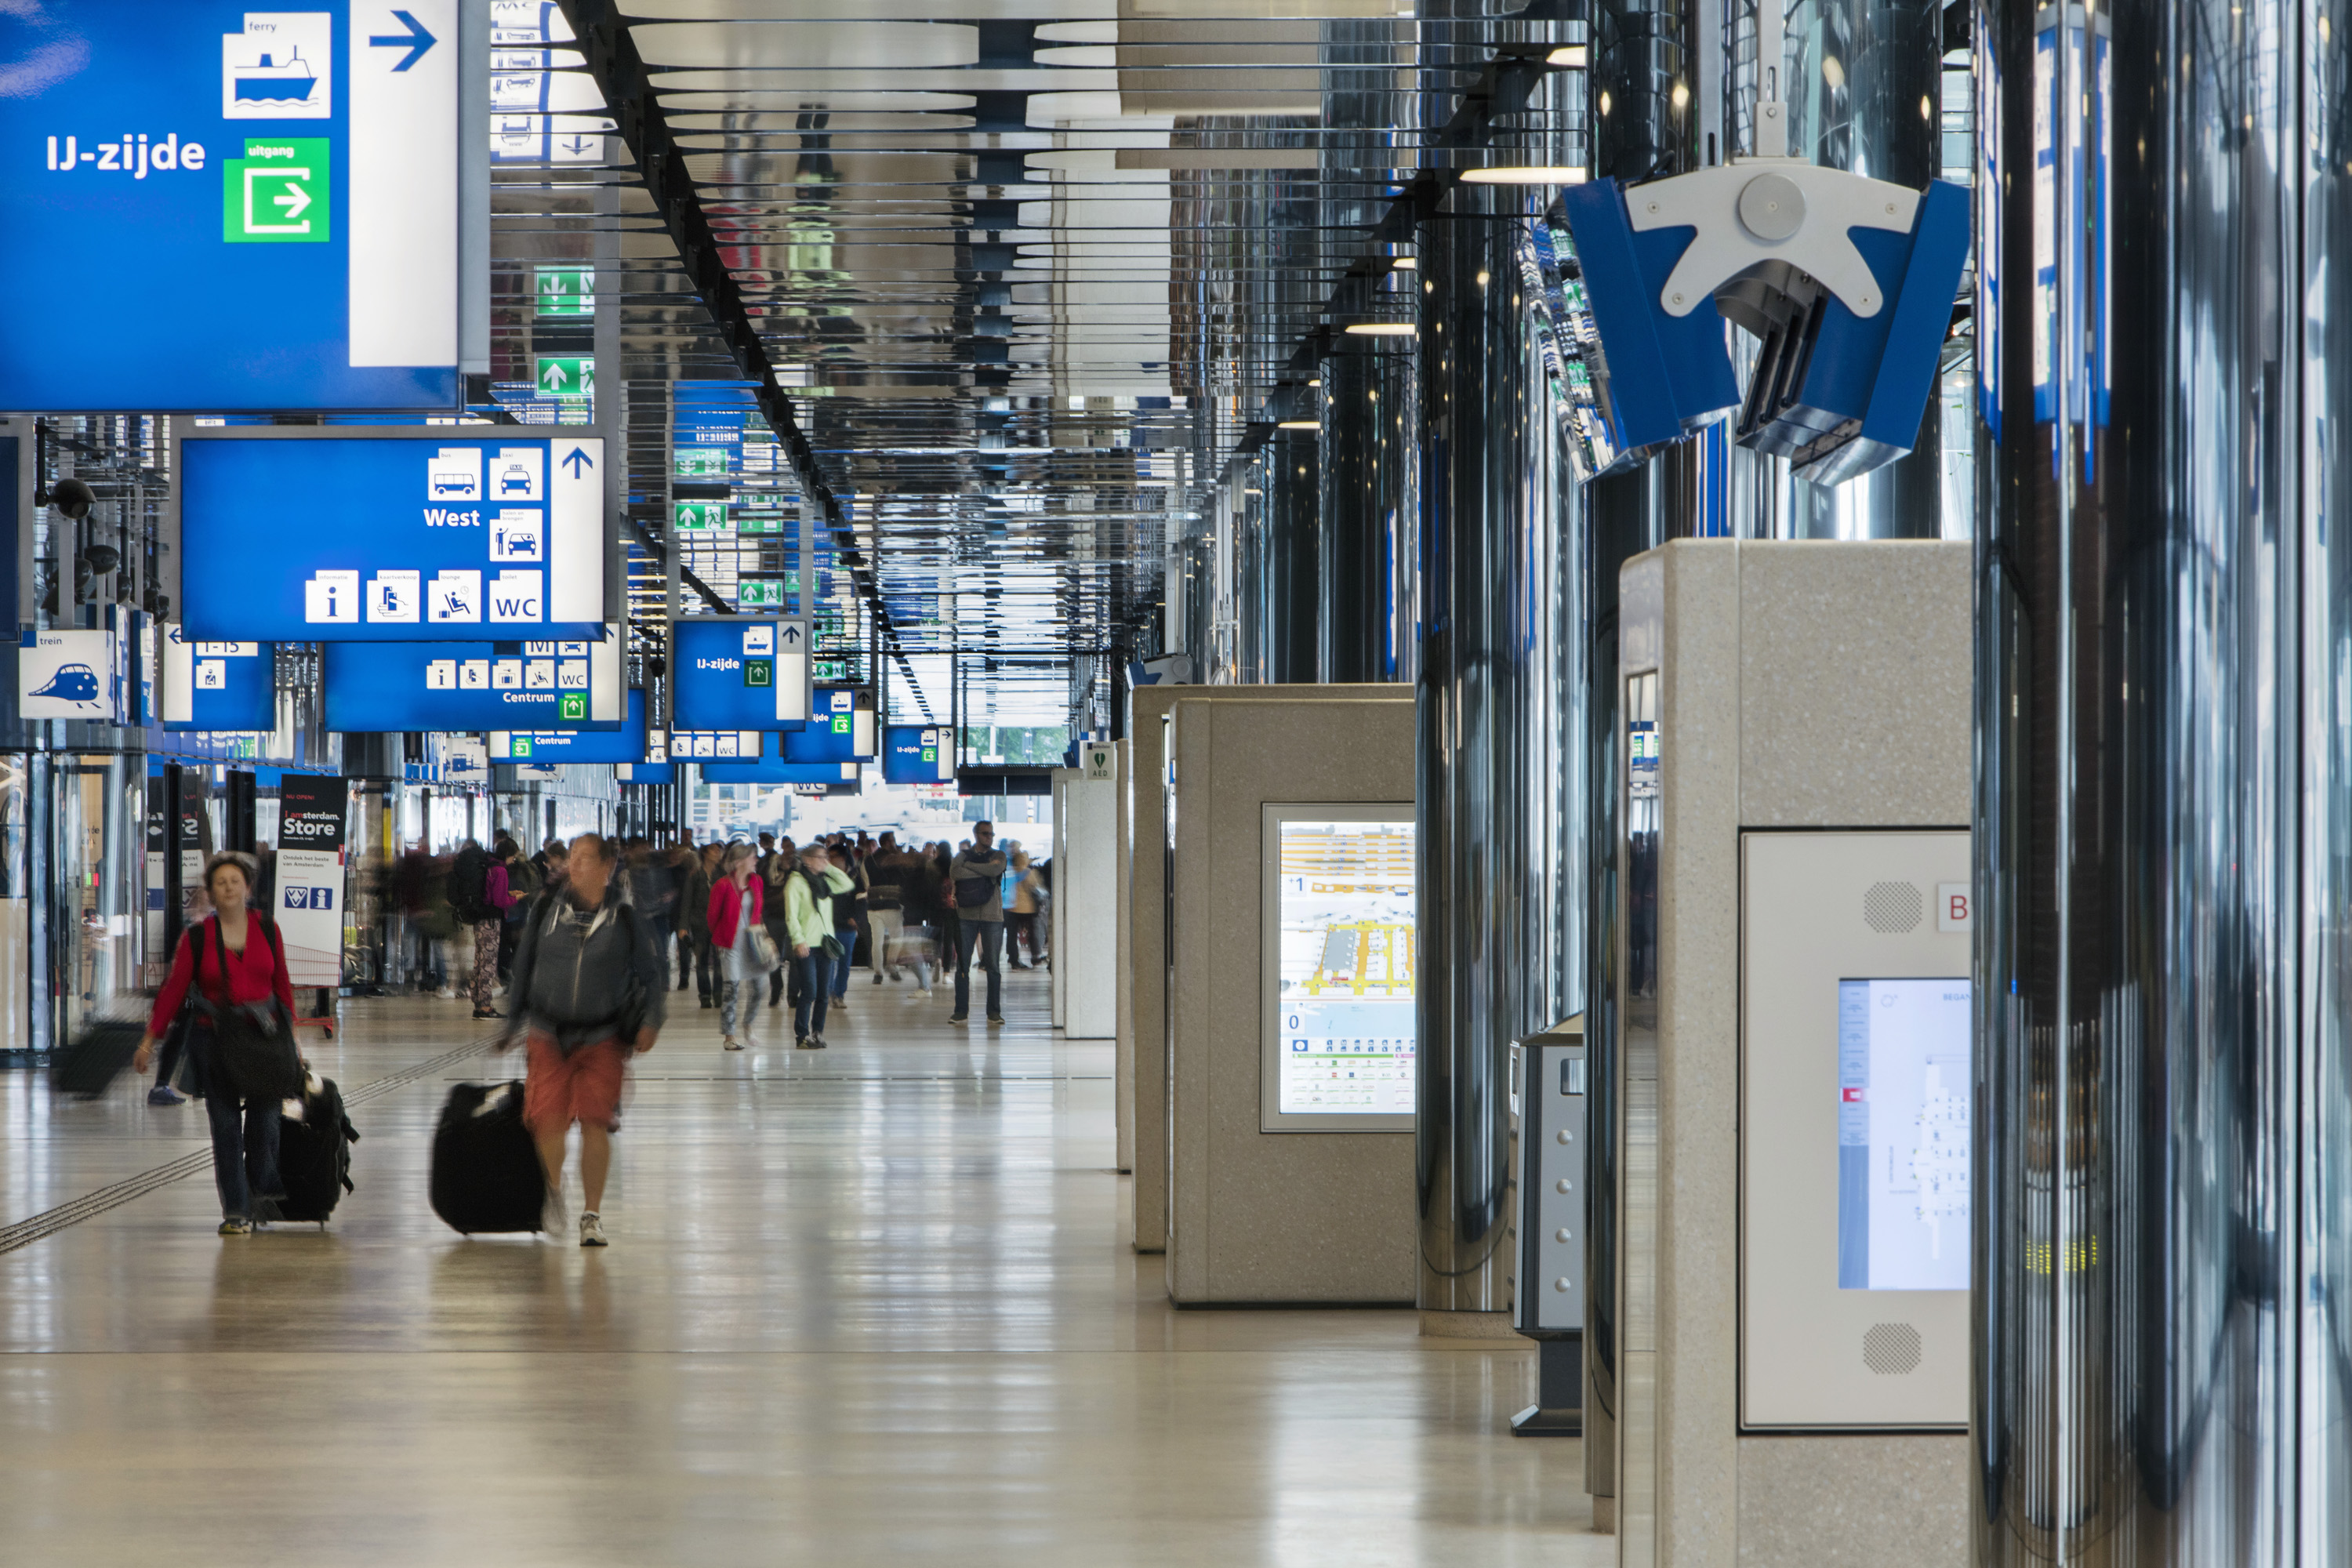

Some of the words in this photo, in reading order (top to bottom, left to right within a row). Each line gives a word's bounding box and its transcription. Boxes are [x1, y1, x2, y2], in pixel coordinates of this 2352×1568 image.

[249, 22, 277, 33] ferry
[47, 132, 206, 180] IJ-zijde
[248, 145, 295, 158] uitgang
[423, 508, 481, 527] West
[495, 598, 537, 617] WC
[39, 636, 63, 645] trein
[696, 658, 740, 672] IJ-zijde
[561, 674, 584, 685] WC
[503, 691, 555, 702] Centrum
[535, 736, 572, 746] Centrum
[283, 817, 336, 837] Store
